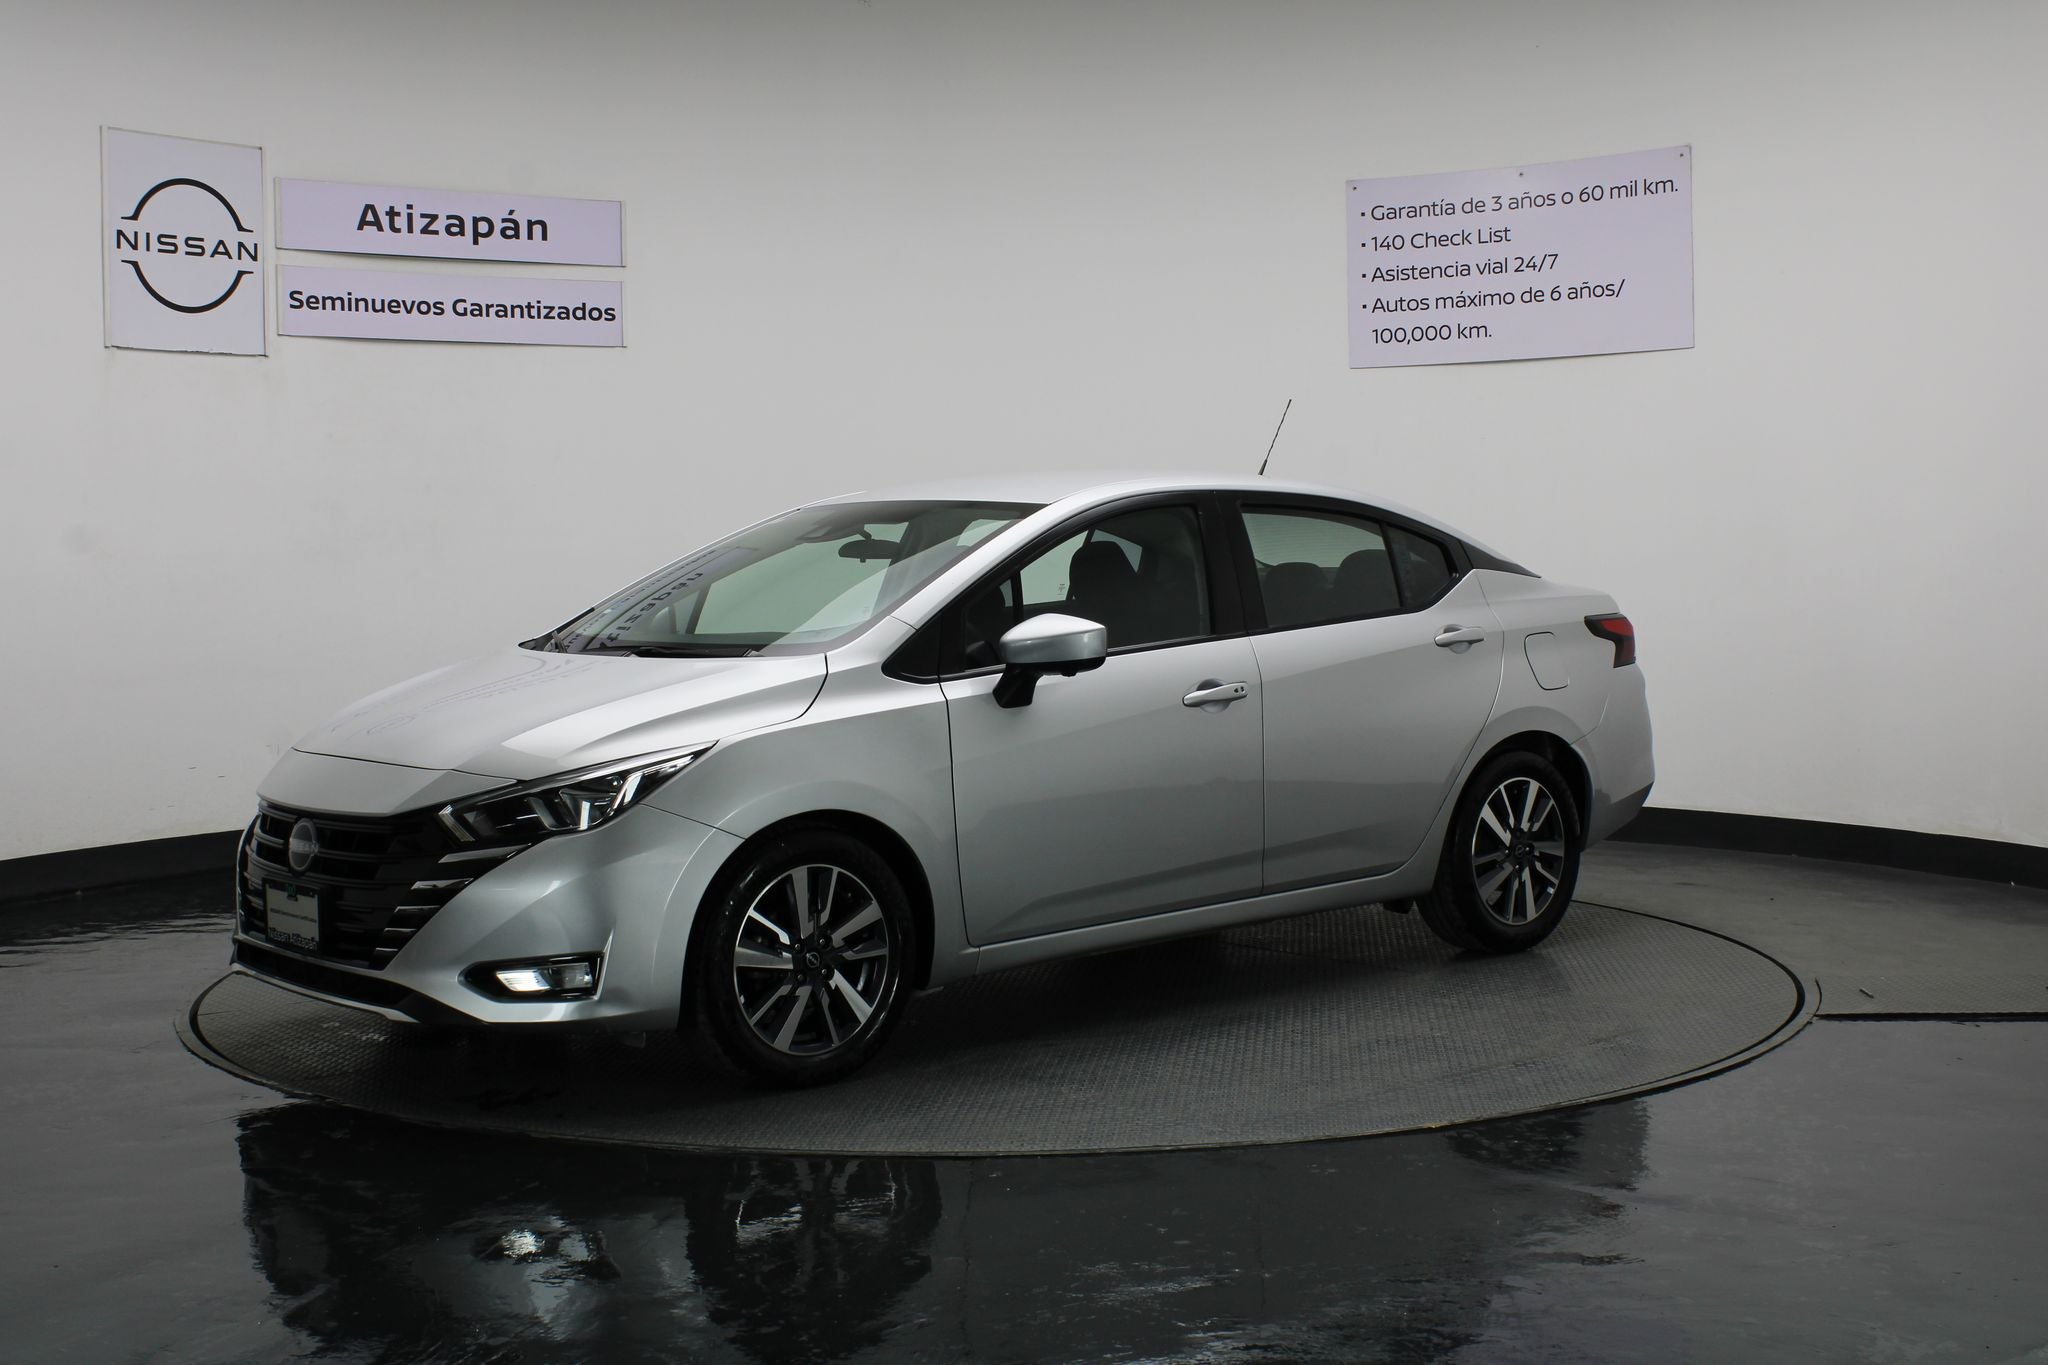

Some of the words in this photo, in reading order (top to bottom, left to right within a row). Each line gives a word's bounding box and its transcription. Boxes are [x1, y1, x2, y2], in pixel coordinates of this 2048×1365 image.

[1370, 197, 1456, 222] Garantía
[1461, 197, 1486, 215] de
[1491, 195, 1503, 212] 3
[1508, 190, 1557, 211] años
[1560, 191, 1574, 205] o
[1578, 184, 1605, 203] 60
[1609, 179, 1638, 200] mil
[1643, 177, 1680, 196] km.
[355, 202, 549, 246] Atizapán
[1370, 234, 1406, 252] 140
[1410, 228, 1473, 250] Check
[1477, 225, 1512, 245] List
[115, 228, 259, 263] NISSAN
[1370, 259, 1471, 283] Asistencia
[1475, 256, 1508, 276] vial
[1513, 253, 1559, 274] 24/7
[288, 289, 446, 317] Seminuevos
[451, 298, 617, 322] Garantizados
[1371, 296, 1430, 314] Autos
[1435, 290, 1516, 311] máximo
[1520, 286, 1545, 304] de
[1549, 284, 1562, 302] 6
[1567, 278, 1626, 301] años/
[1371, 324, 1452, 346] 100,000
[1457, 322, 1493, 340] km.
